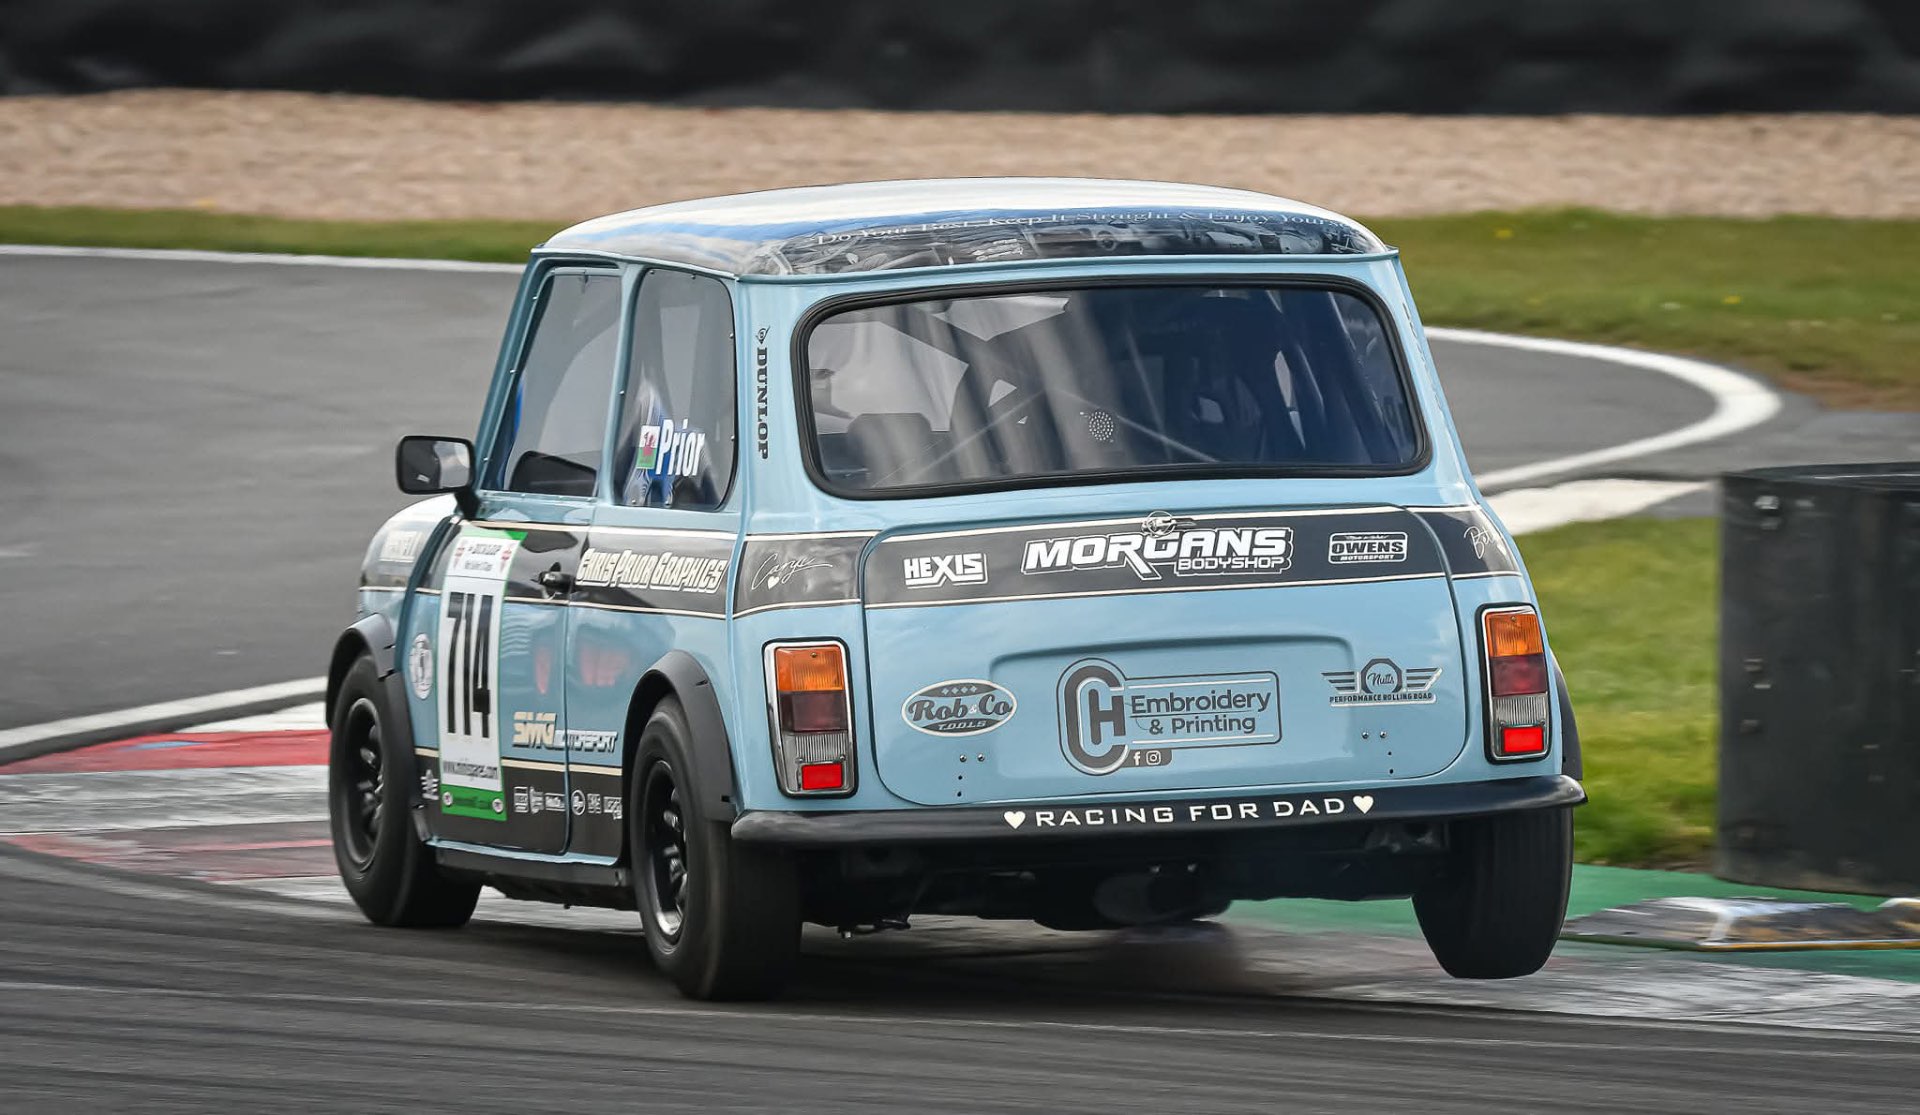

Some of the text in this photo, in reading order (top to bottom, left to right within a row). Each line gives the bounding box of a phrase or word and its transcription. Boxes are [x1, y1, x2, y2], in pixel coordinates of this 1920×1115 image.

[1076, 211, 1169, 222] Straight
[1209, 211, 1273, 225] Enjoy
[756, 346, 769, 460] DUNLOP
[655, 418, 705, 477] Prior
[1024, 529, 1288, 576] MORGANS
[1331, 541, 1404, 554] OWENS
[1340, 553, 1396, 562] MOTORSPORT
[576, 548, 729, 593] CHRIS PRIOR GRAPHICS
[903, 553, 986, 587] HEXIS
[1177, 556, 1285, 571] BODYSHOP
[447, 591, 494, 738] 714
[1131, 689, 1272, 714] Embroidery
[1329, 692, 1433, 703] PERFORMANCE ROLLING ROAD
[937, 720, 987, 731] TOOLS
[1149, 714, 1256, 735] & Printing
[1035, 798, 1346, 827] RACING FOR DAD
